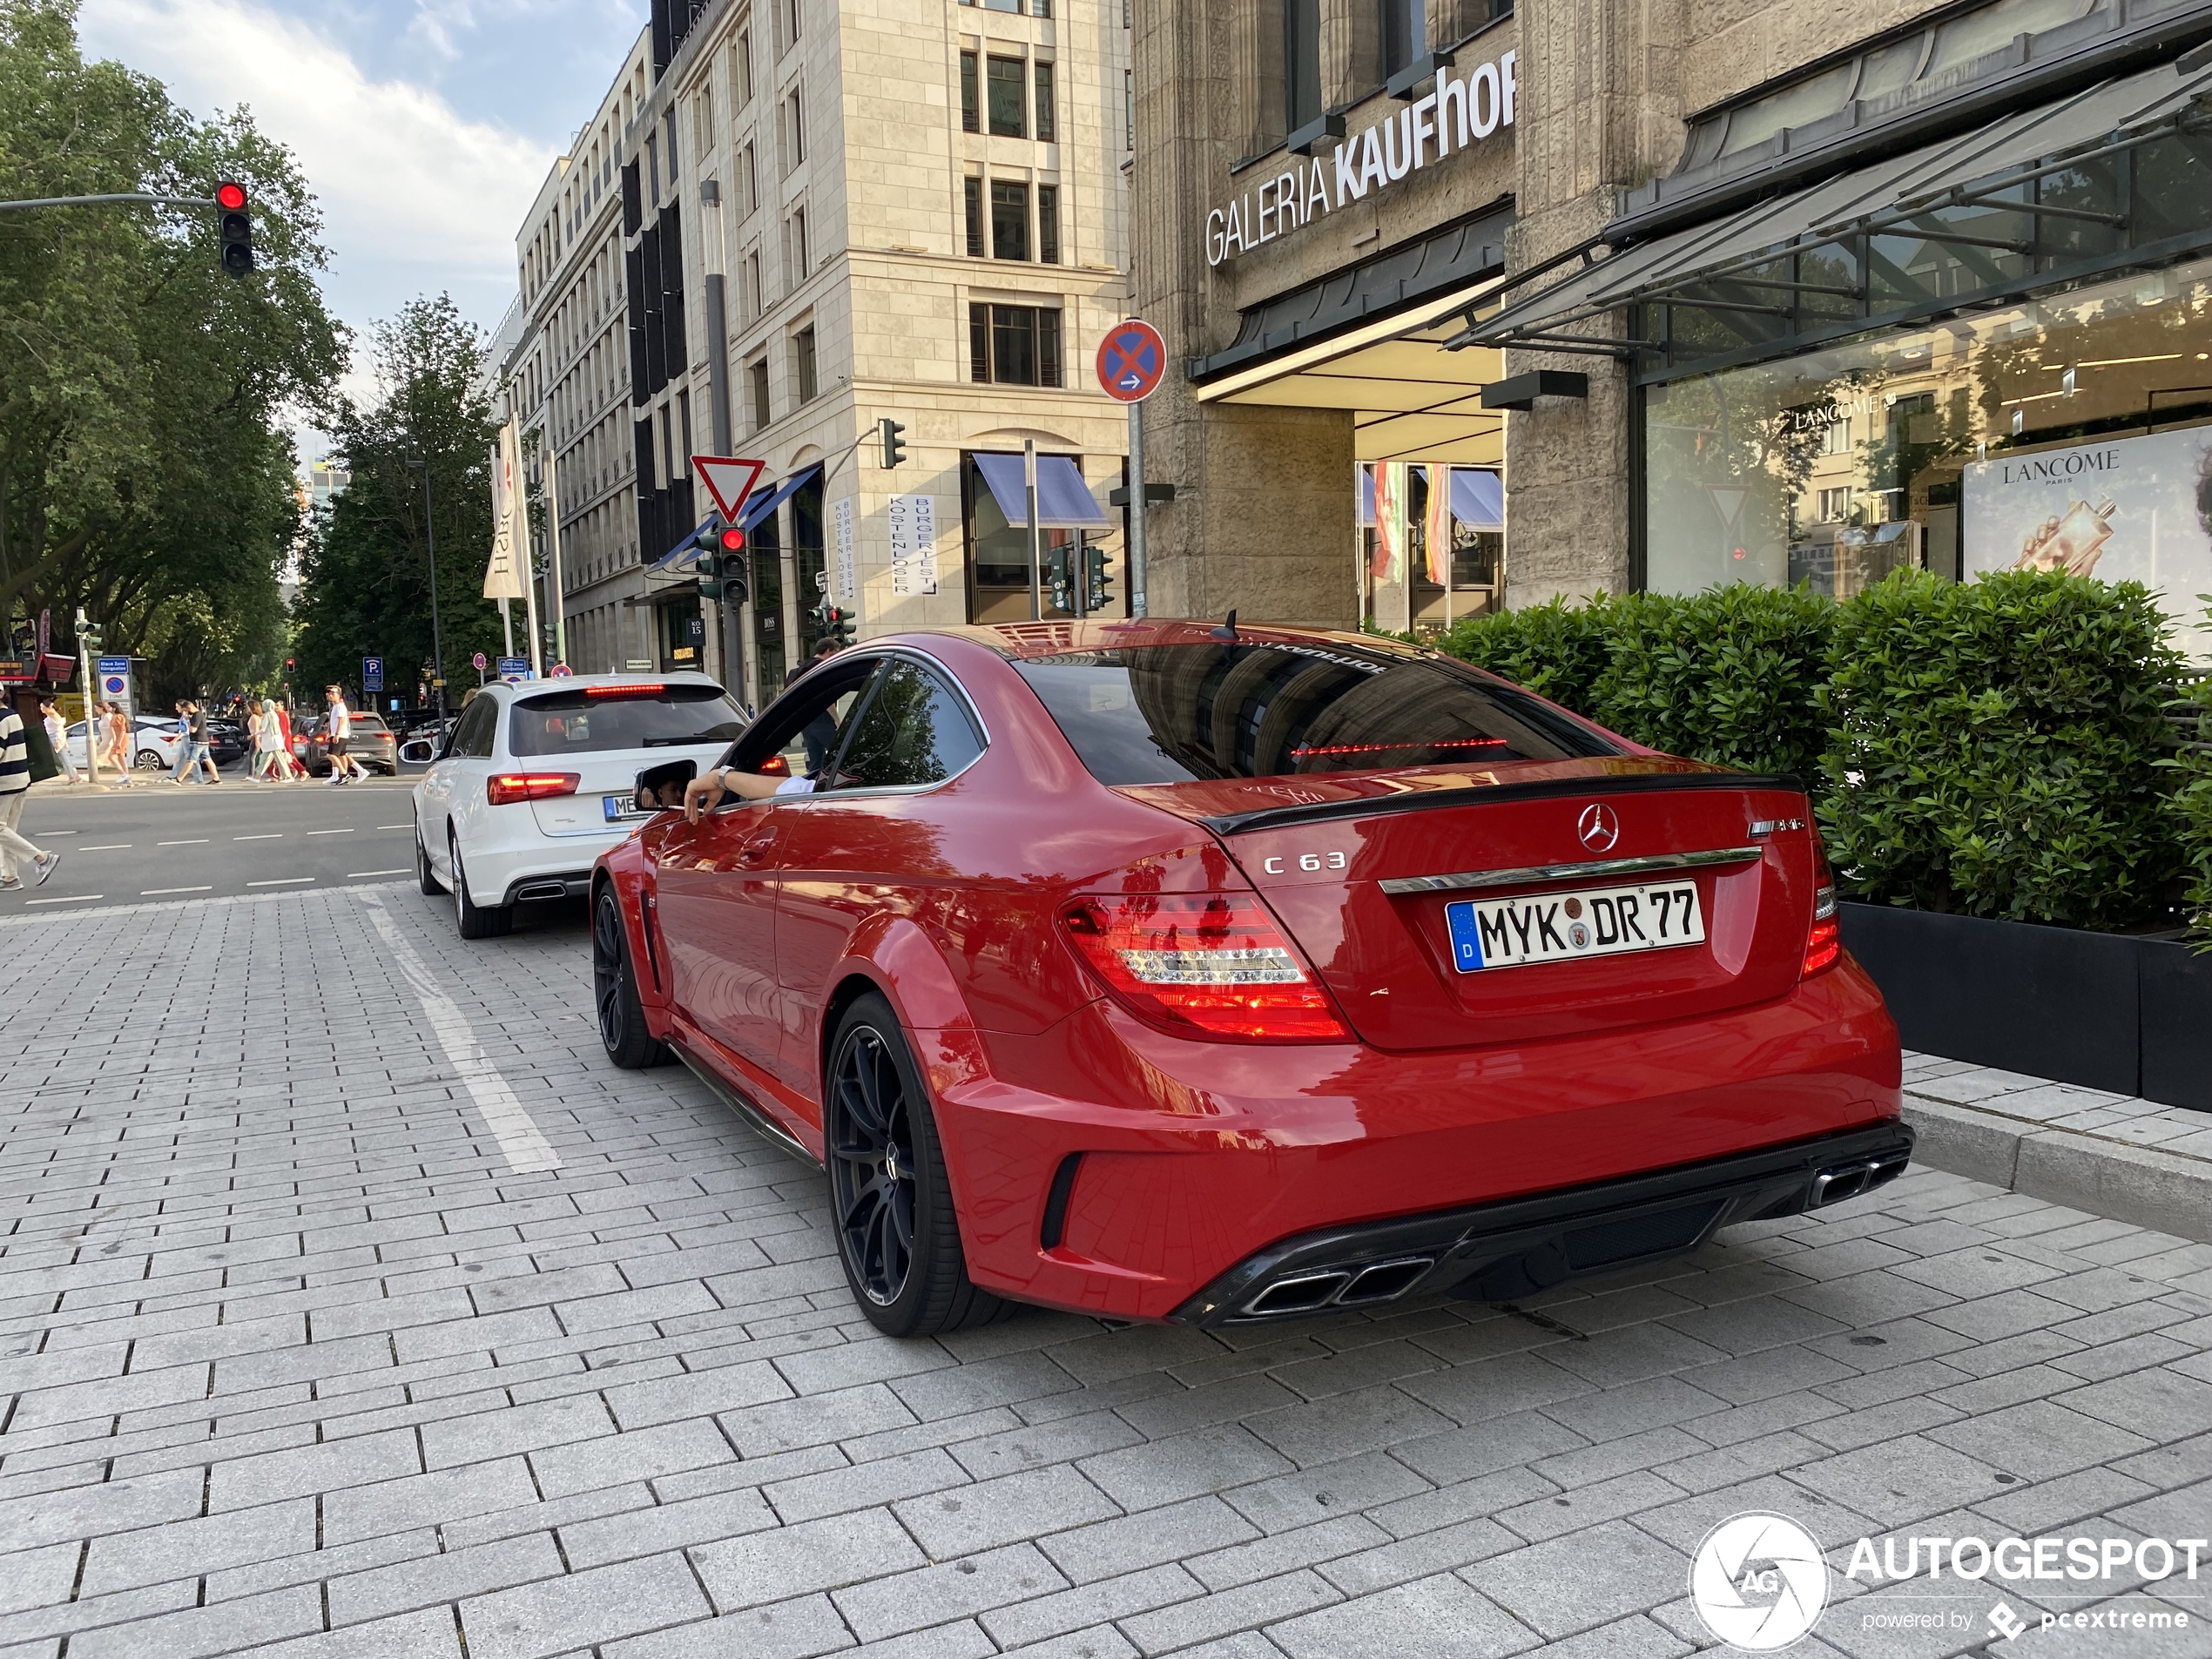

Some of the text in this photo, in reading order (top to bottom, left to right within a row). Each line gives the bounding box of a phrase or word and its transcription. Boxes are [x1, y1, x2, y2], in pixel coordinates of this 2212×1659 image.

[1206, 156, 1331, 266] GALERIA
[2004, 448, 2120, 484] LANCÔME
[2046, 477, 2073, 486] PARIS
[835, 504, 846, 597] KOSTENLOSER
[844, 501, 853, 586] BÜRGERTEST
[890, 497, 908, 593] KOSTENLOSER
[915, 498, 934, 584] BÜRGERTEST
[691, 626, 701, 634] 15
[1264, 851, 1346, 874] C 63
[1462, 944, 1474, 958] D
[1478, 889, 1694, 958] MYK DR 77
